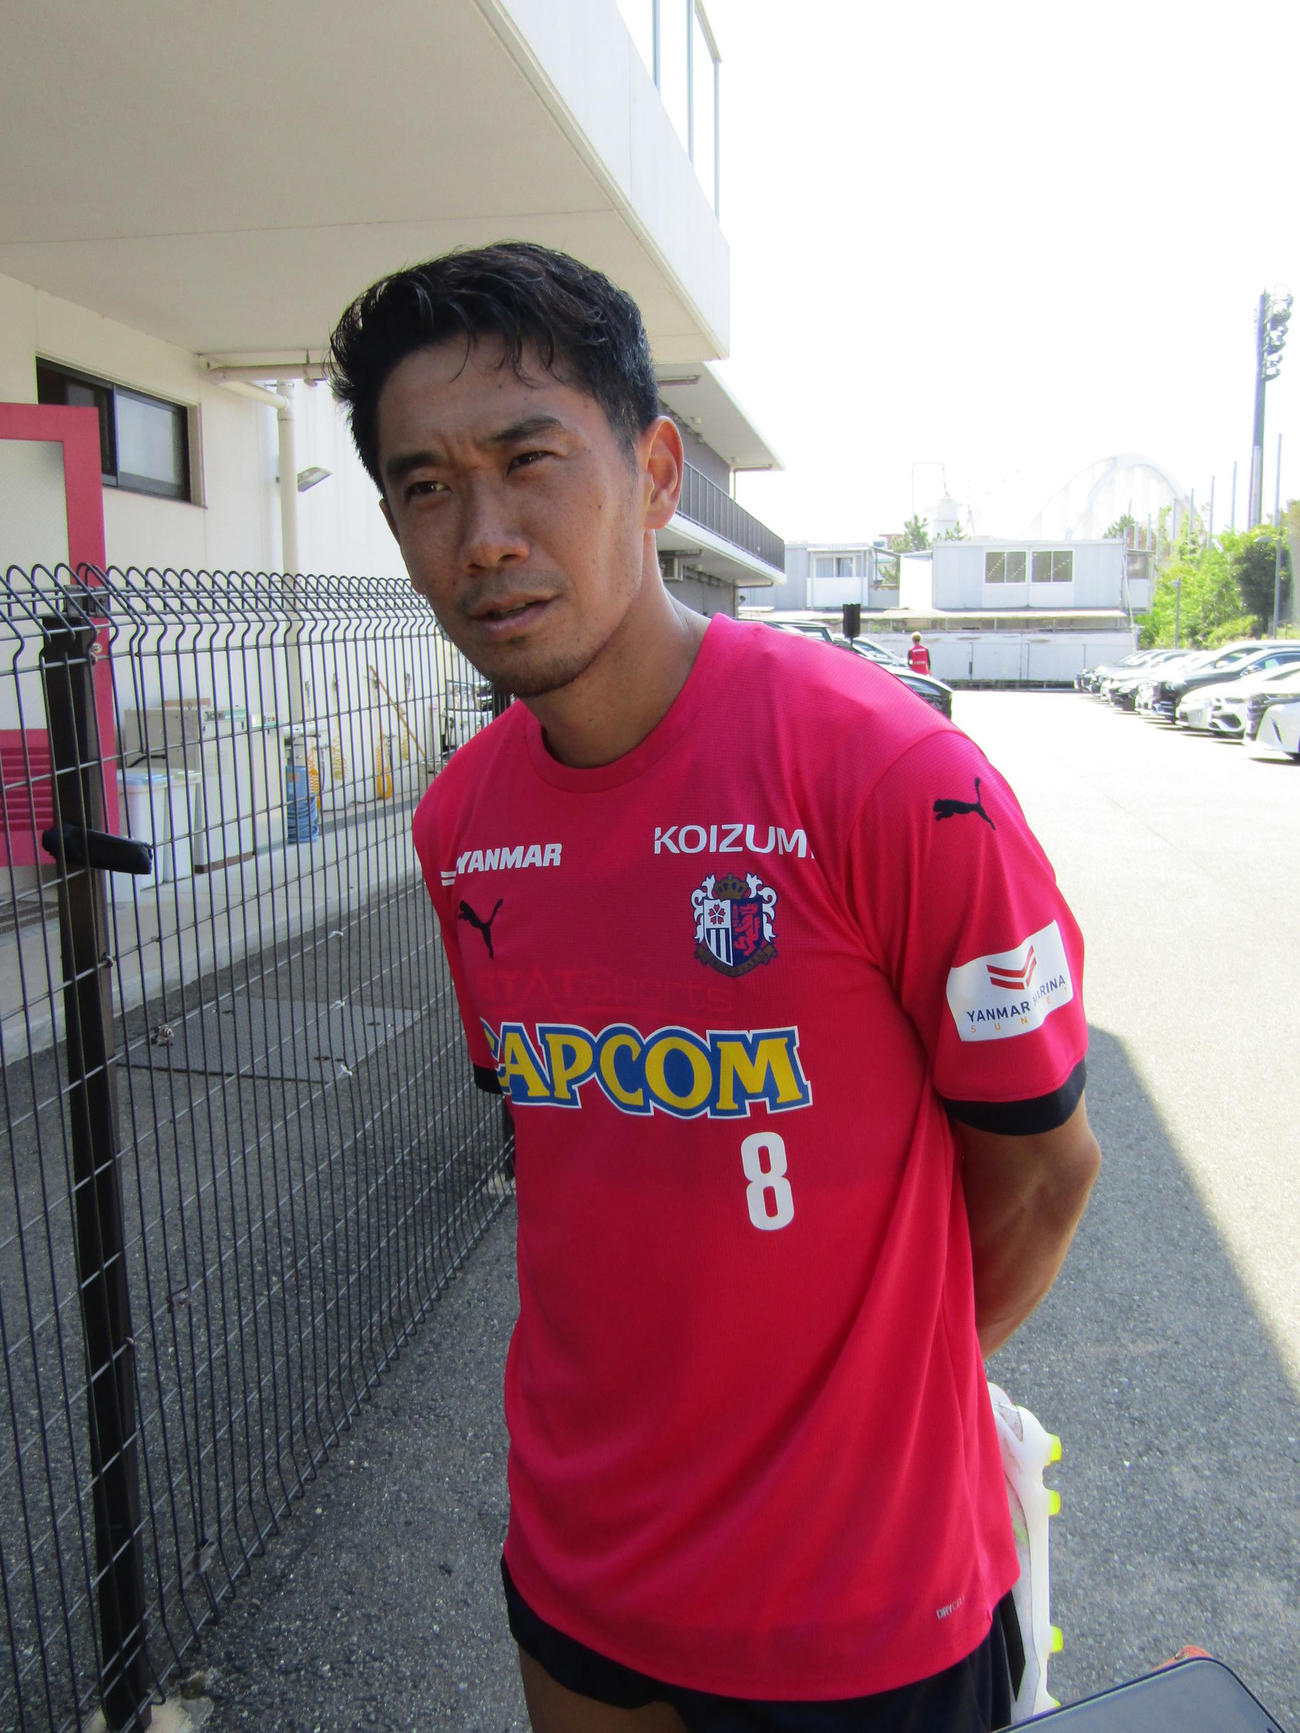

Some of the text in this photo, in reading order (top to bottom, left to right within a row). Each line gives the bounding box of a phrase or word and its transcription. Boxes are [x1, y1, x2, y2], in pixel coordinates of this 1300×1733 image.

[456, 843, 563, 875] YANMAR
[654, 823, 815, 859] KOIZUM
[966, 1001, 1030, 1023] YANMAR
[480, 1018, 813, 1120] APCOM
[740, 1131, 795, 1231] 8
